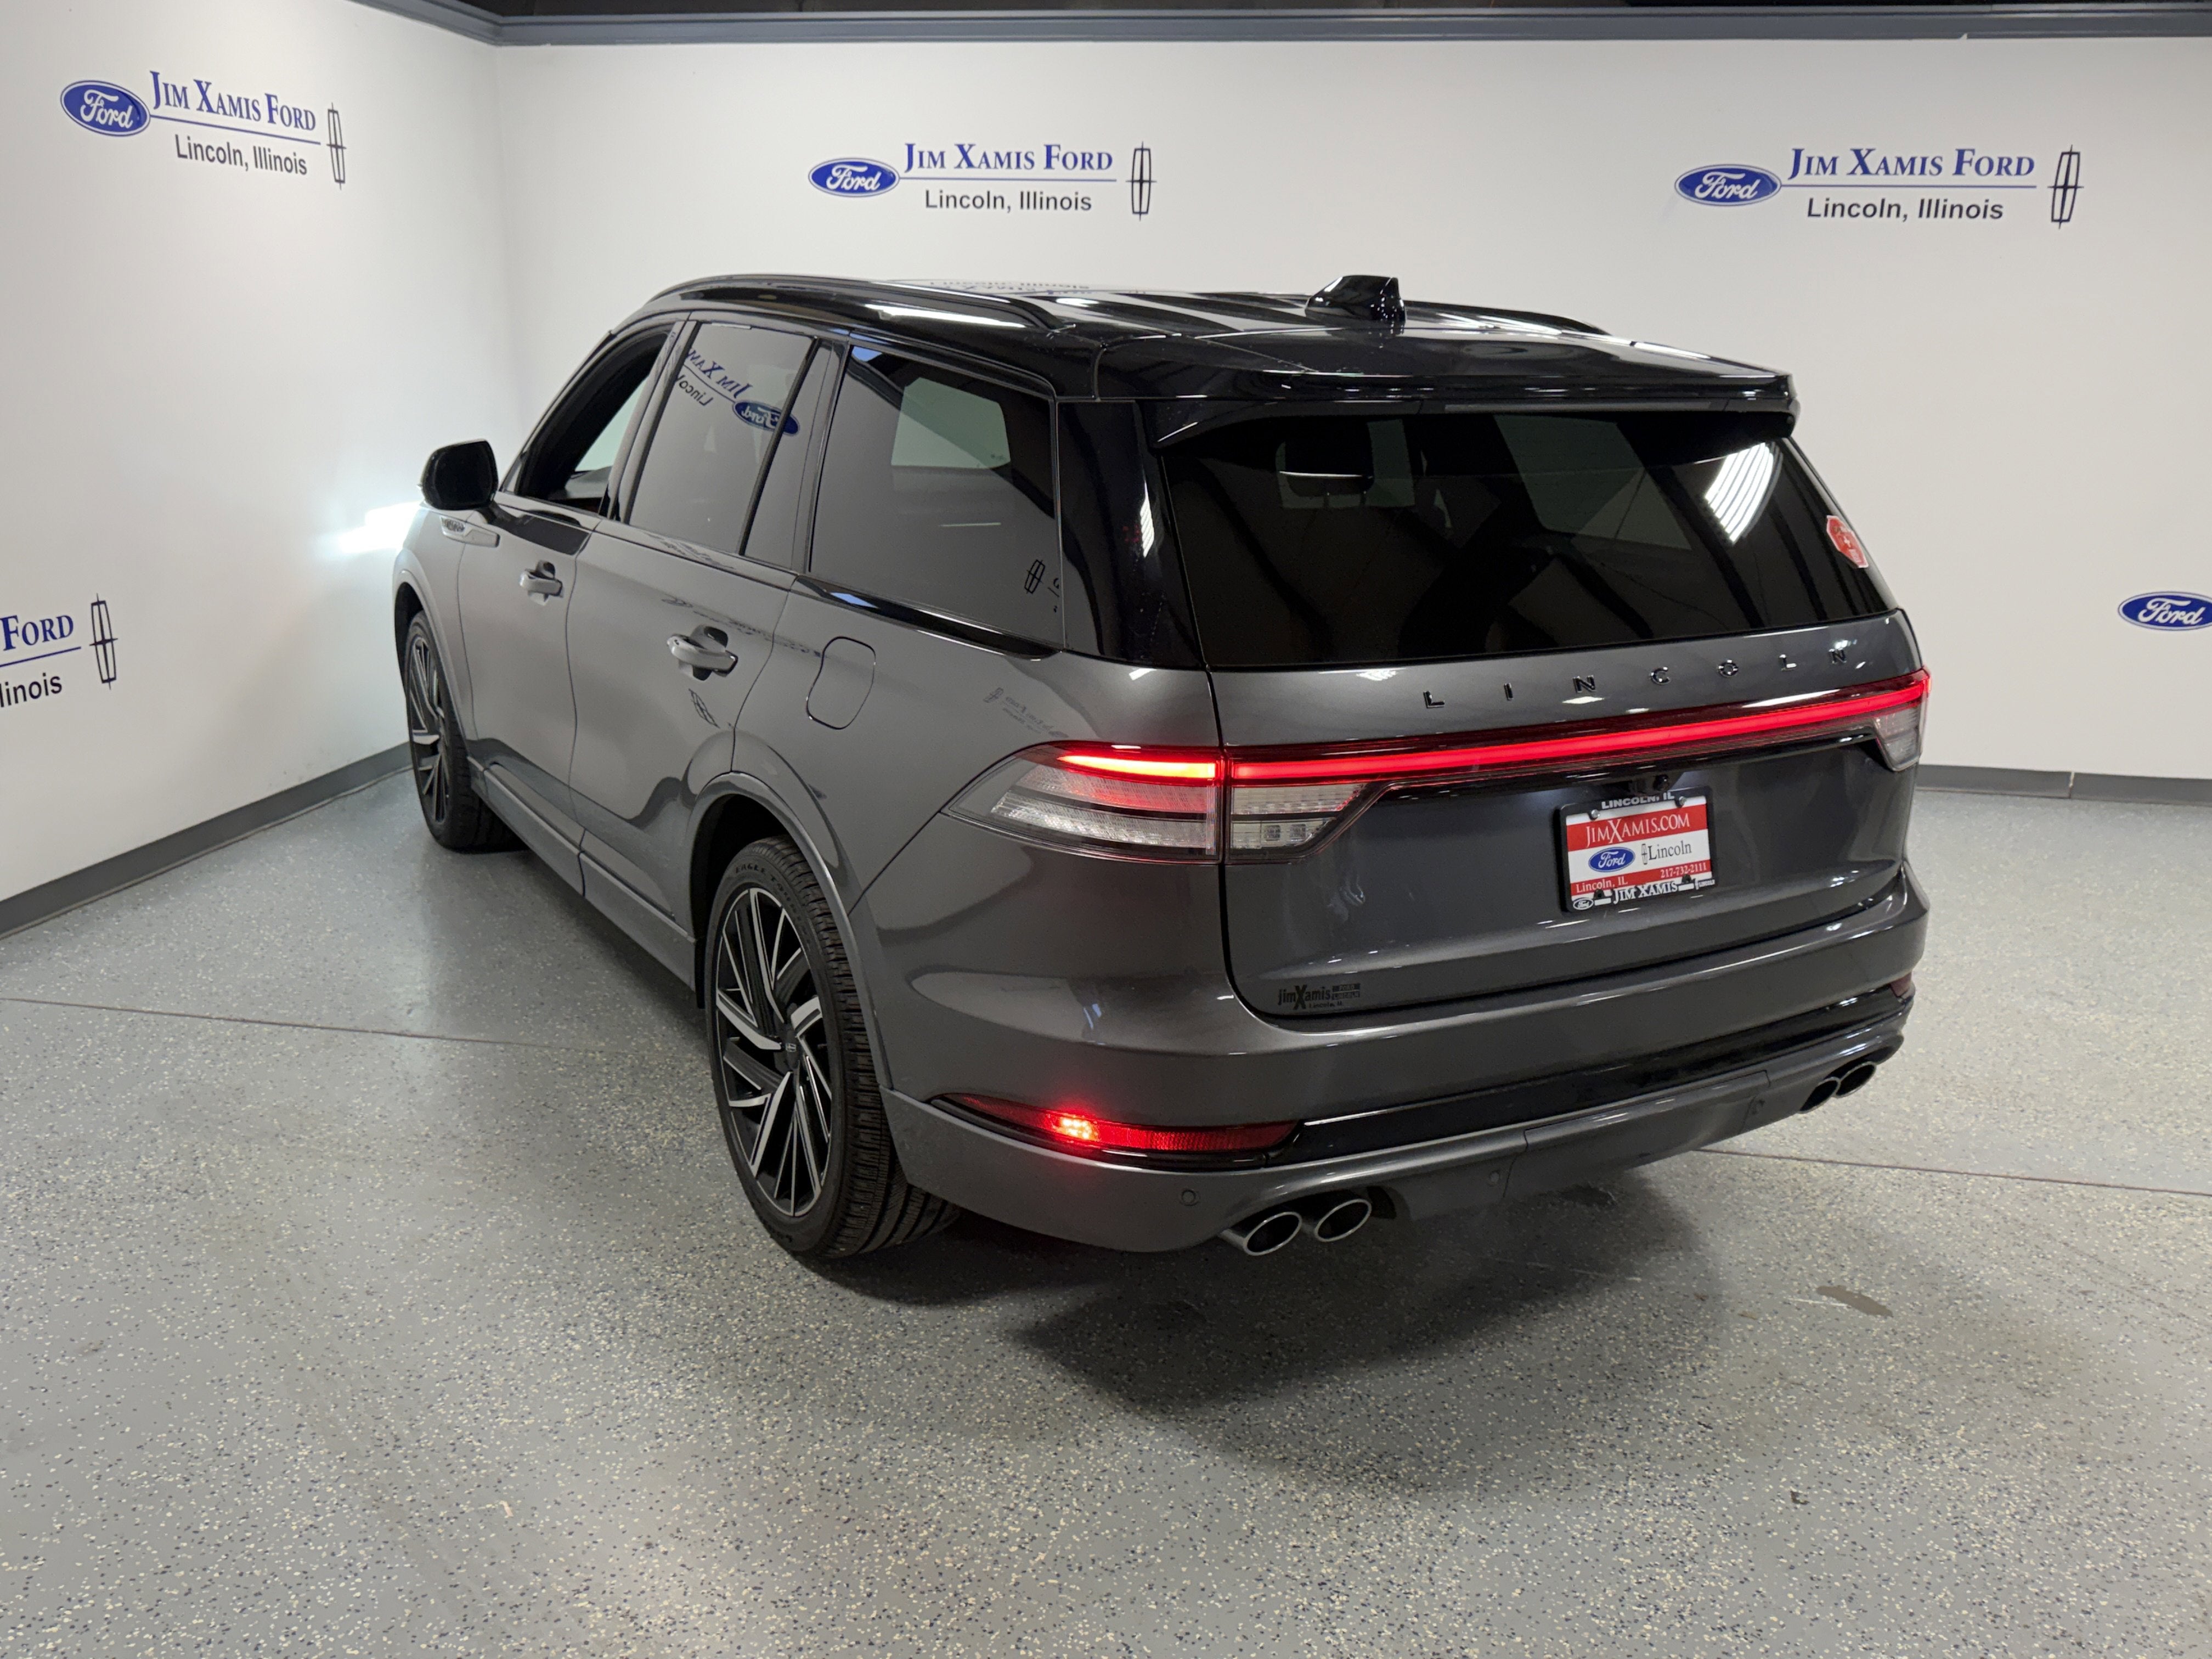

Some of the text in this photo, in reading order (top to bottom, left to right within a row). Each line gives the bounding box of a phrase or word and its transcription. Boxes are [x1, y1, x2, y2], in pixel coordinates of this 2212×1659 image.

[80, 88, 133, 129] Ford
[150, 70, 316, 131] JIM XAMIS FORD
[174, 134, 308, 175] Lincoln, Illinois
[905, 143, 1113, 173] JIM XAMIS FORD
[1788, 148, 2035, 180] JIM XAMIS FORD
[826, 164, 881, 198] Ford
[1694, 171, 1760, 200] Ford
[925, 190, 1092, 213] Lincoln, Illinois
[1807, 198, 2004, 222] Lincoln, Illinois
[2137, 597, 2207, 625] Ford
[0, 614, 74, 651] FORD
[1423, 648, 1847, 709] LINCOLN
[1663, 792, 1675, 800] IL
[1585, 812, 1690, 848] JIMXAMIS.COM
[1598, 851, 1626, 868] Ford
[1647, 840, 1692, 861] Lincoln
[1618, 876, 1628, 886] IL
[1660, 862, 1707, 878] 217-732-2111
[1613, 888, 1637, 905] JIM
[1638, 881, 1678, 898] XAMIS
